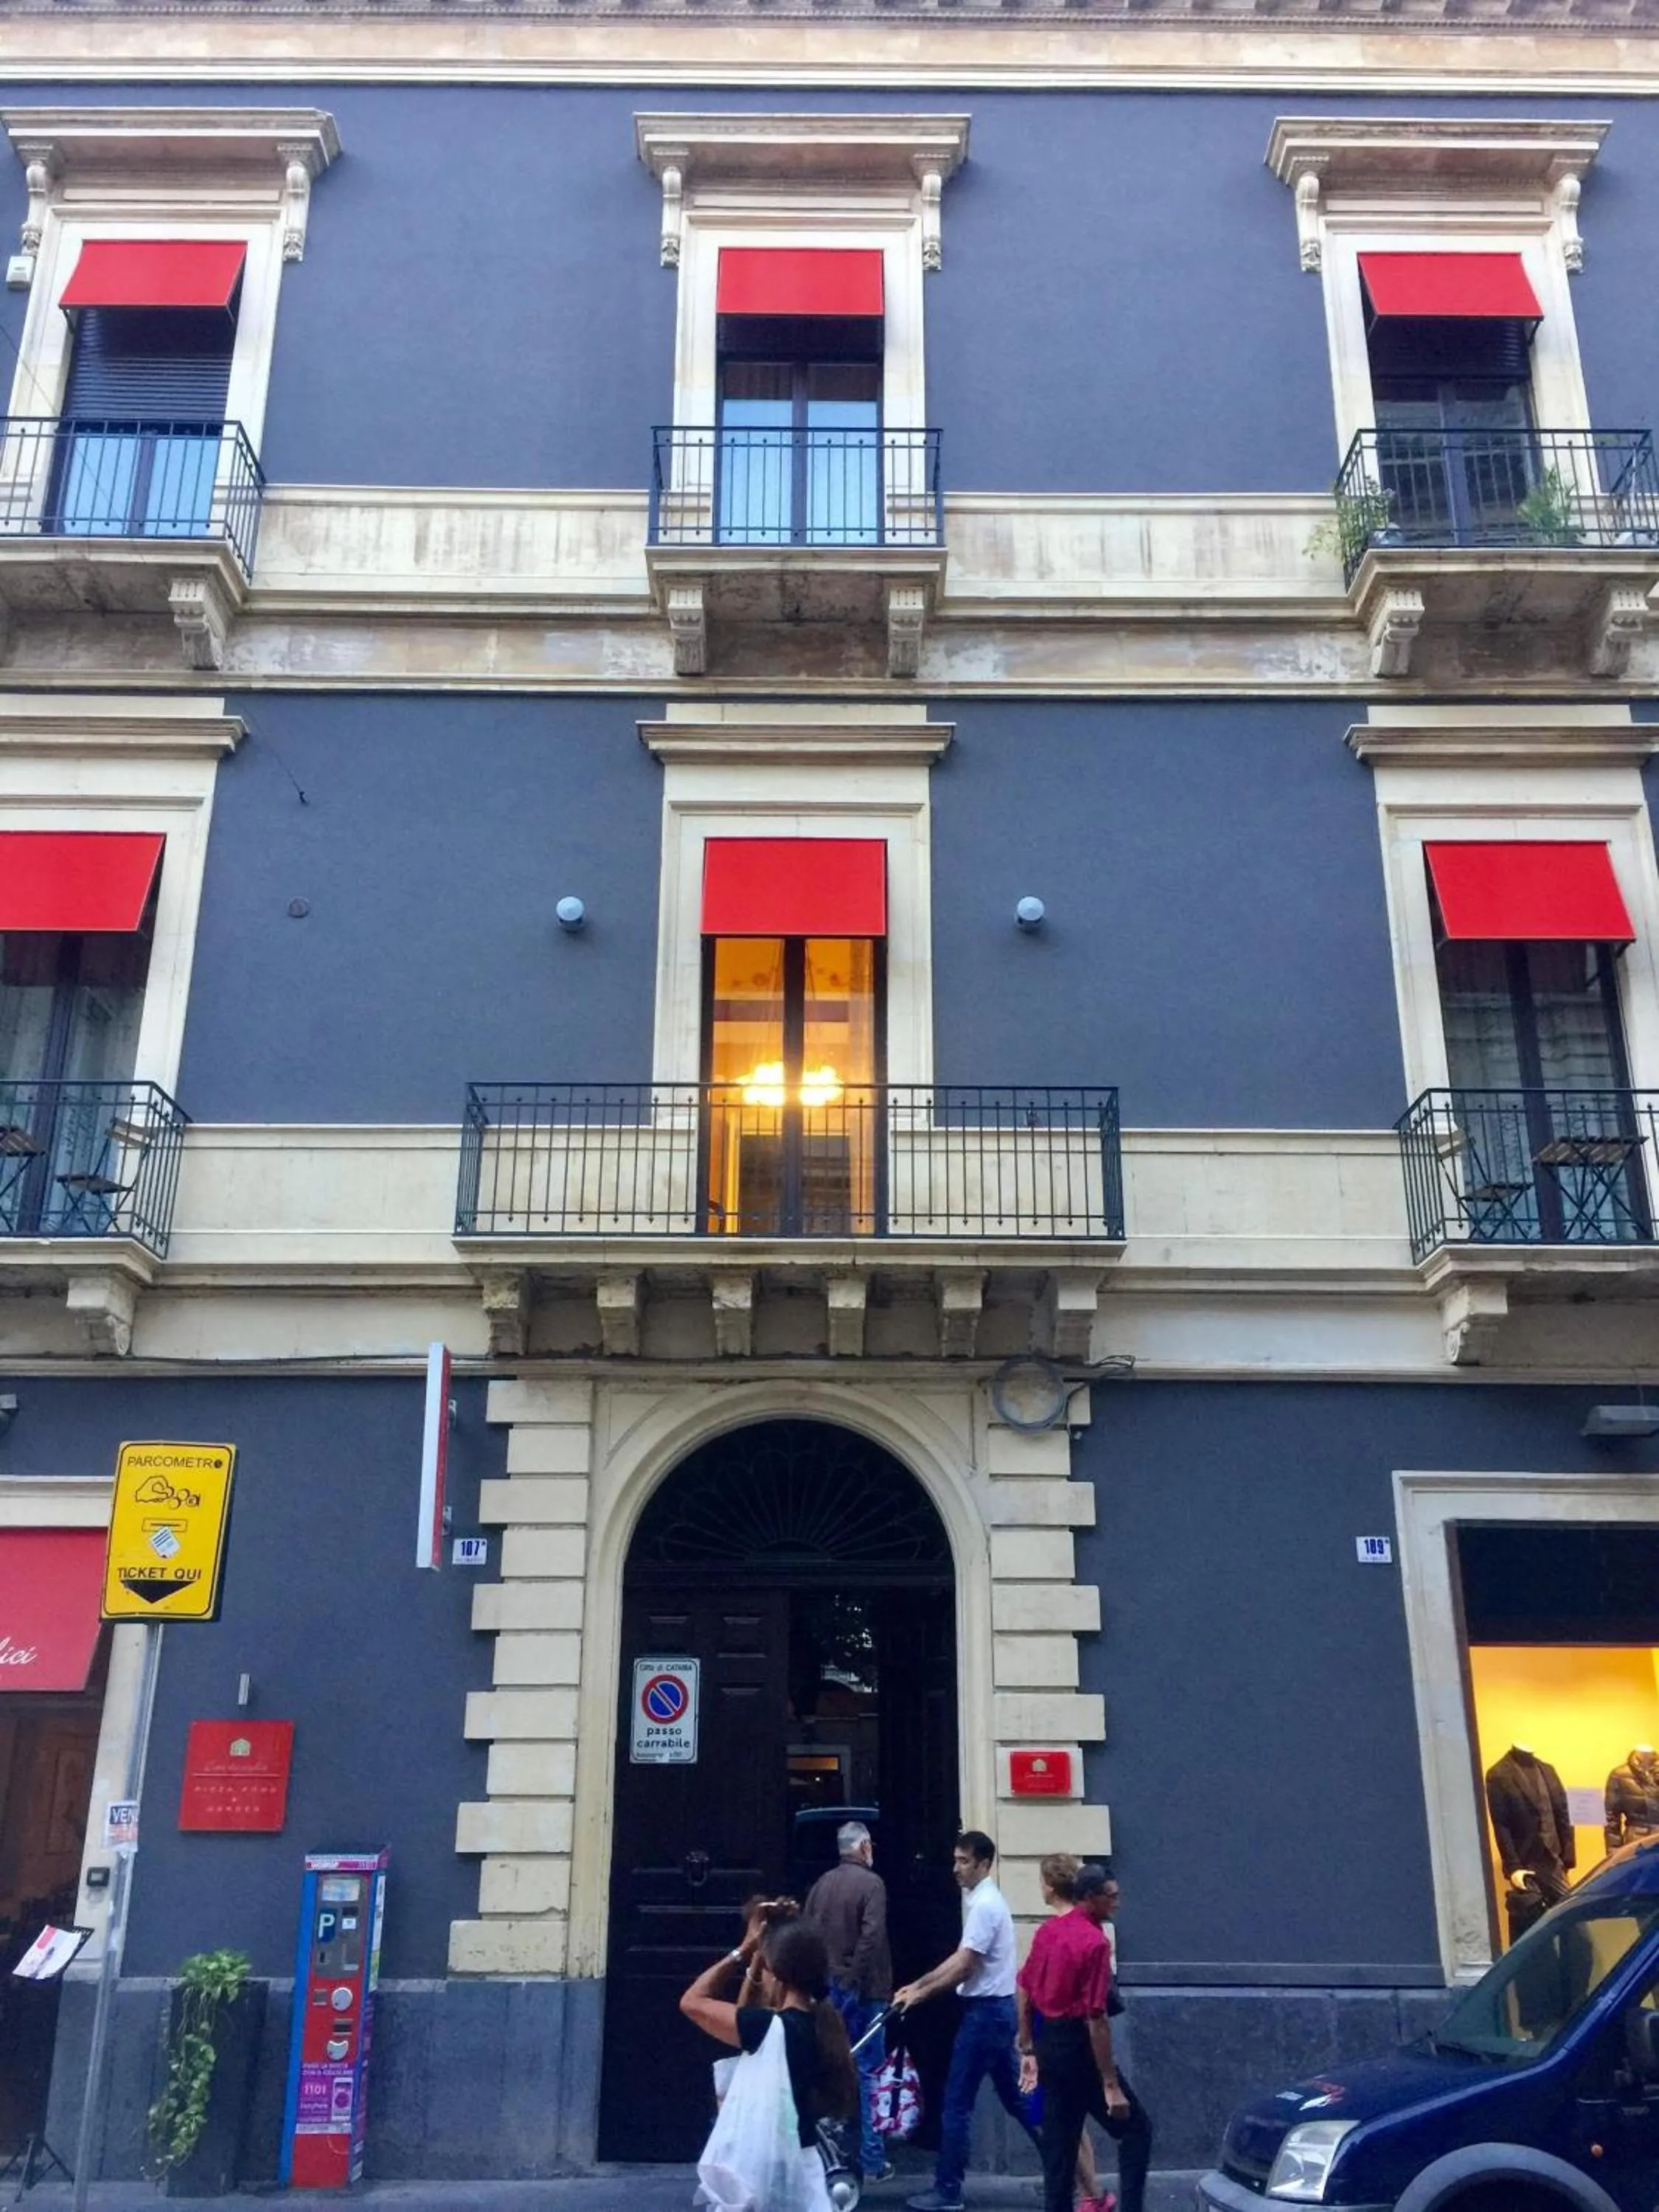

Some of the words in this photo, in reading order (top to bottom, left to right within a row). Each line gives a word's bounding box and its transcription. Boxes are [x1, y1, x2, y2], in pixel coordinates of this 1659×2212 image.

[118, 1567, 167, 1579] TICKET
[174, 1568, 201, 1579] QUI
[647, 1727, 682, 1737] passo
[636, 1738, 691, 1748] carrabile
[318, 1913, 335, 1938] P
